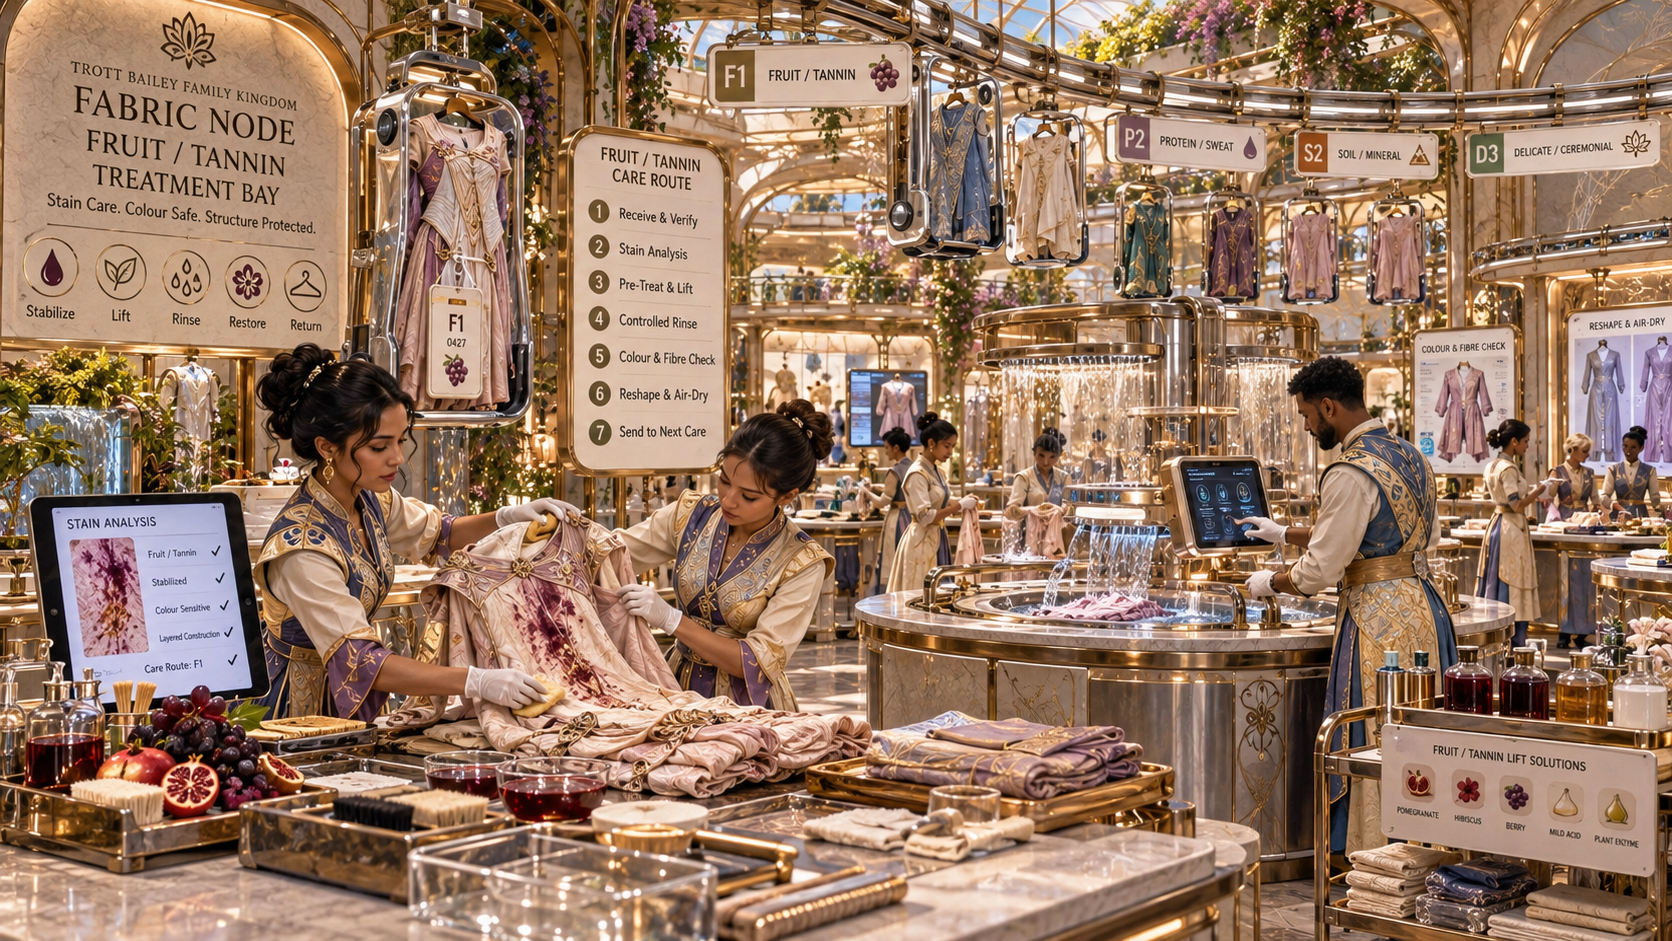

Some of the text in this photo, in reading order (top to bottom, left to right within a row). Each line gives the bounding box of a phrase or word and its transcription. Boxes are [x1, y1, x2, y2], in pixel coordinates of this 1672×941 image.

[724, 64, 746, 88] F1
[769, 69, 856, 82] FRUIT / TANNIN
[70, 60, 297, 111] TROTT BAILEY FAMILY KINGDOM
[74, 85, 296, 146] FABRIC NODE
[1125, 128, 1145, 149] P2
[1160, 136, 1234, 152] PROTEIN / SWEAT
[86, 129, 286, 177] FRUIT / TANNIN
[1304, 143, 1323, 162] S2
[1338, 149, 1402, 161] SOIL / MINERAL
[1476, 144, 1498, 163] D3
[1514, 142, 1613, 157] DELICATE / CEREMONIAL
[601, 147, 701, 172] FRUIT / TANNIN
[93, 164, 280, 206] TREATMENT BAY
[612, 169, 692, 190] CARE ROUTE
[47, 192, 316, 235] Stain Care. Colour Safe. Structure Protected.
[596, 204, 698, 229] 1 Receive & Verify
[595, 240, 688, 262] 2 Stain Analysis
[595, 275, 693, 294] 3 Pre-Treat & Lift
[26, 305, 75, 321] Stabilize
[111, 309, 131, 323] Lift
[172, 313, 201, 326] Rinse
[595, 311, 698, 329] 4 Controlled Rinse
[229, 316, 266, 330] Restore
[290, 319, 322, 332] Return
[449, 314, 463, 332] F1
[1589, 317, 1666, 330] RESHAPE & AIR-DRY
[447, 338, 466, 347] 0427
[1422, 342, 1506, 354] COLOUR & FIBRE CHECK
[595, 349, 716, 365] 5 Colour & Fibre Check
[595, 386, 709, 404] 6 Reshape & Air-Dry
[596, 425, 706, 440] 7 Send to Next Care
[67, 516, 157, 530] STAIN ANALYSIS
[148, 549, 196, 558] Fruit / Tannin
[155, 604, 210, 614] Colour Sensitive
[159, 633, 183, 643] Layered
[144, 660, 203, 674] Care Route: F1
[1433, 745, 1587, 772] FRUIT / TANNIN LIFT SOLUTIONS
[1506, 822, 1526, 831] BERRY
[1549, 828, 1581, 839] MILD ACID
[1594, 835, 1614, 844] PLANT
